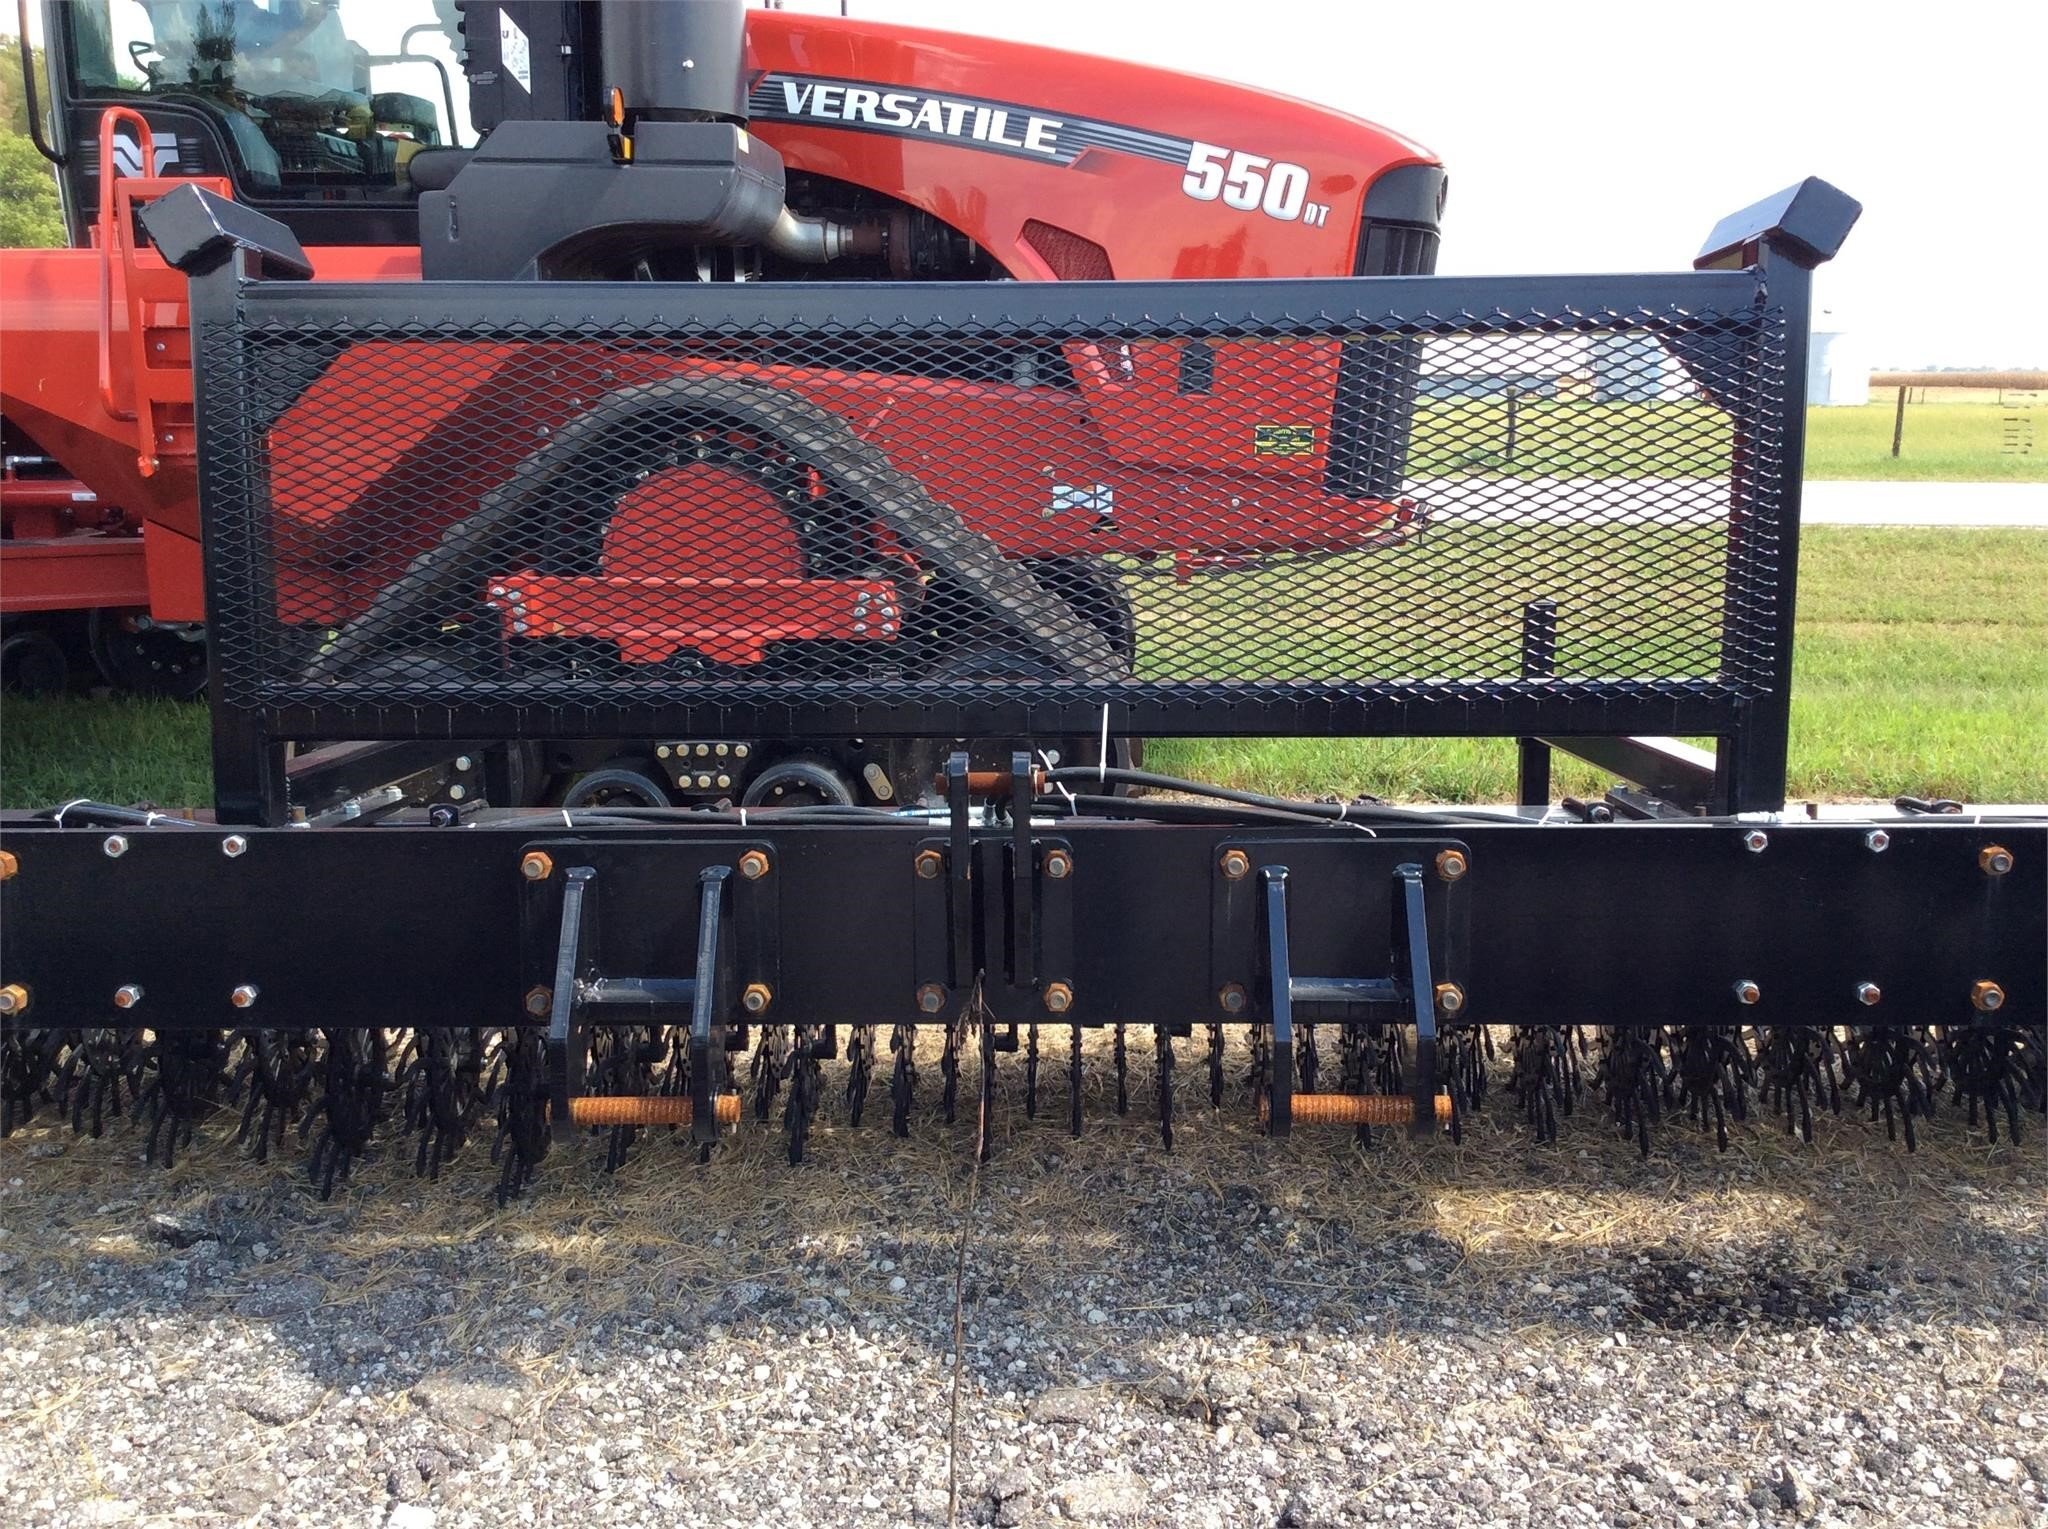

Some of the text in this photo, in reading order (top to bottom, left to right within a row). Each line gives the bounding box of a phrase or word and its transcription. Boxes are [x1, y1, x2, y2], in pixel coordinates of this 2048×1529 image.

[782, 82, 1064, 154] VERSATILE
[1182, 141, 1332, 228] 550 DT
